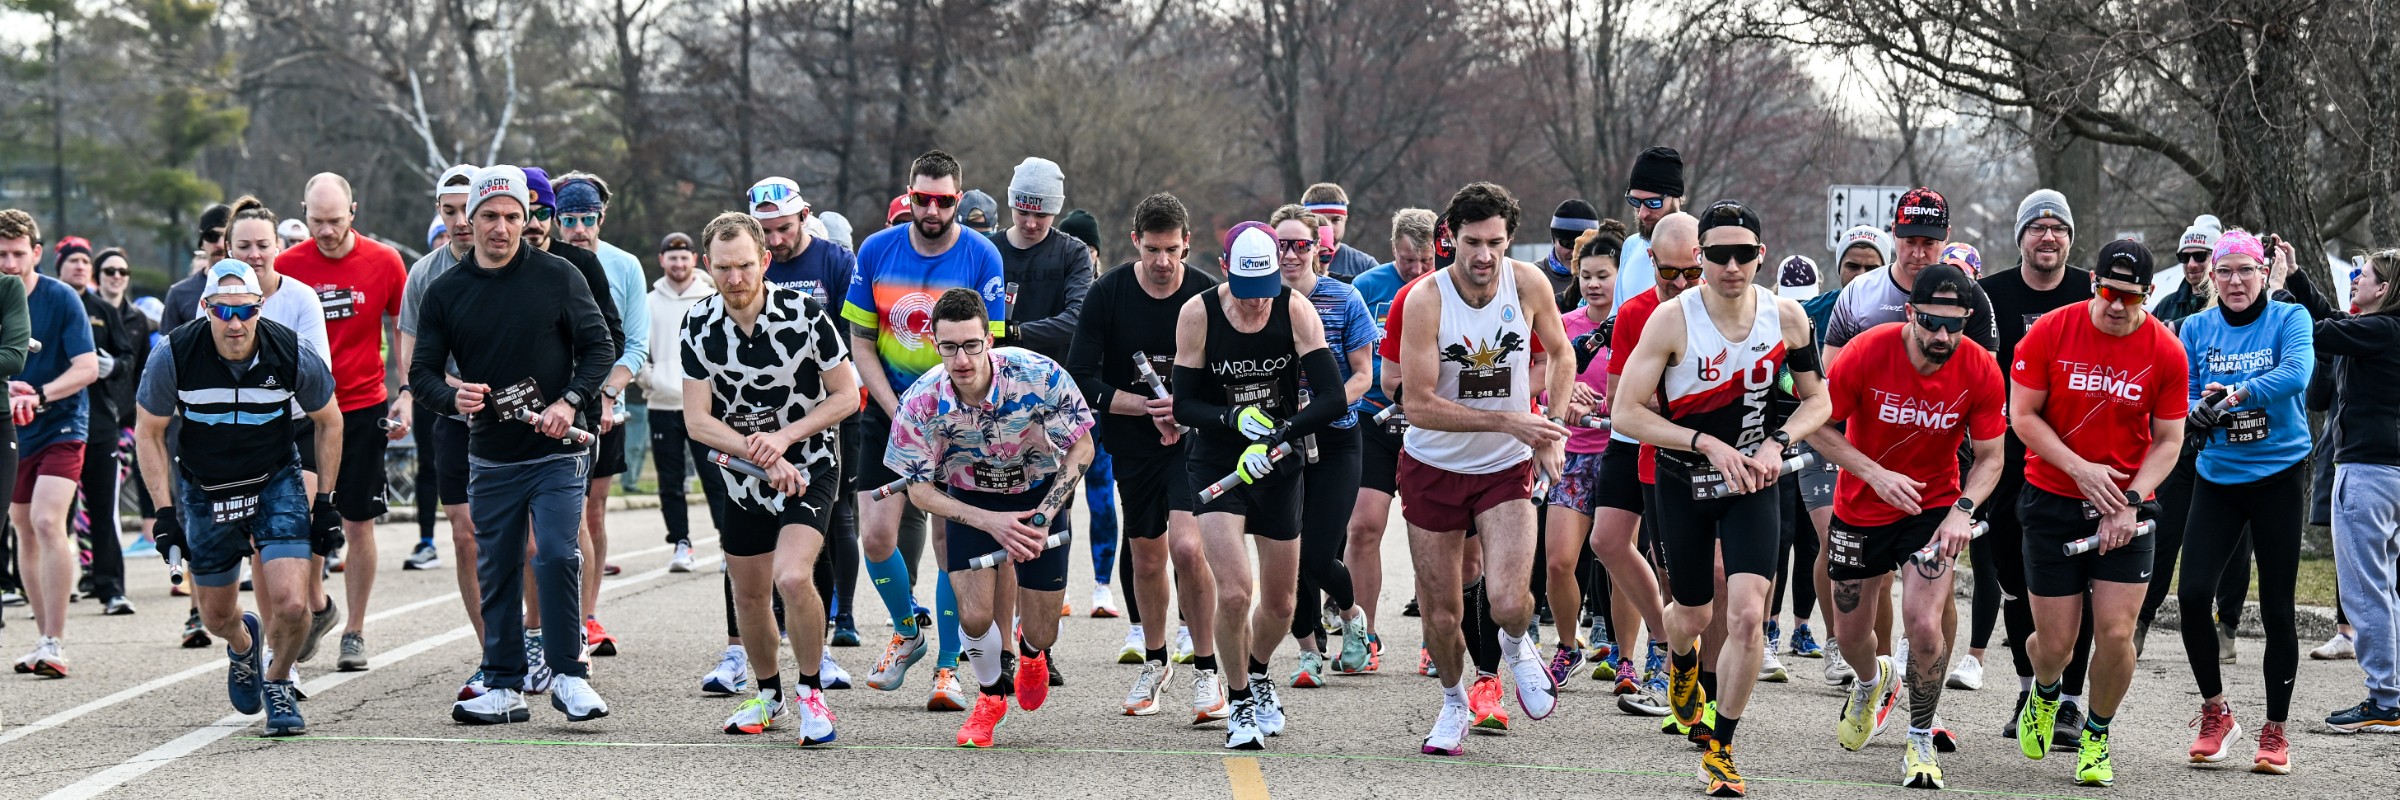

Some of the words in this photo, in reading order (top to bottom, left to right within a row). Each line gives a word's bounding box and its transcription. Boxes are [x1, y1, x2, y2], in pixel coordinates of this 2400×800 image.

[494, 178, 510, 186] CITY
[480, 185, 510, 197] ULTRAS
[1015, 201, 1041, 211] ULTRAS
[1029, 197, 1043, 205] CITY
[1904, 206, 1939, 216] BBMC
[777, 280, 816, 289] MADISON
[2228, 348, 2273, 361] FRANCISCO
[2209, 355, 2274, 372] MARATHON
[2057, 360, 2128, 381] TEAM
[2068, 373, 2143, 401] BBMC
[1235, 388, 1270, 403] HARDLOOP
[1478, 390, 1493, 398] 248
[1869, 387, 1945, 413] TEAM
[1878, 404, 1960, 430] BBMC
[2239, 417, 2266, 429] CROWLEY
[2239, 433, 2253, 441] 229
[1706, 473, 1722, 482] NINJA
[214, 502, 224, 512] ON
[226, 500, 243, 510] YOUR
[244, 495, 259, 507] LEFT
[229, 511, 243, 520] 224
[1834, 554, 1846, 563] 228
